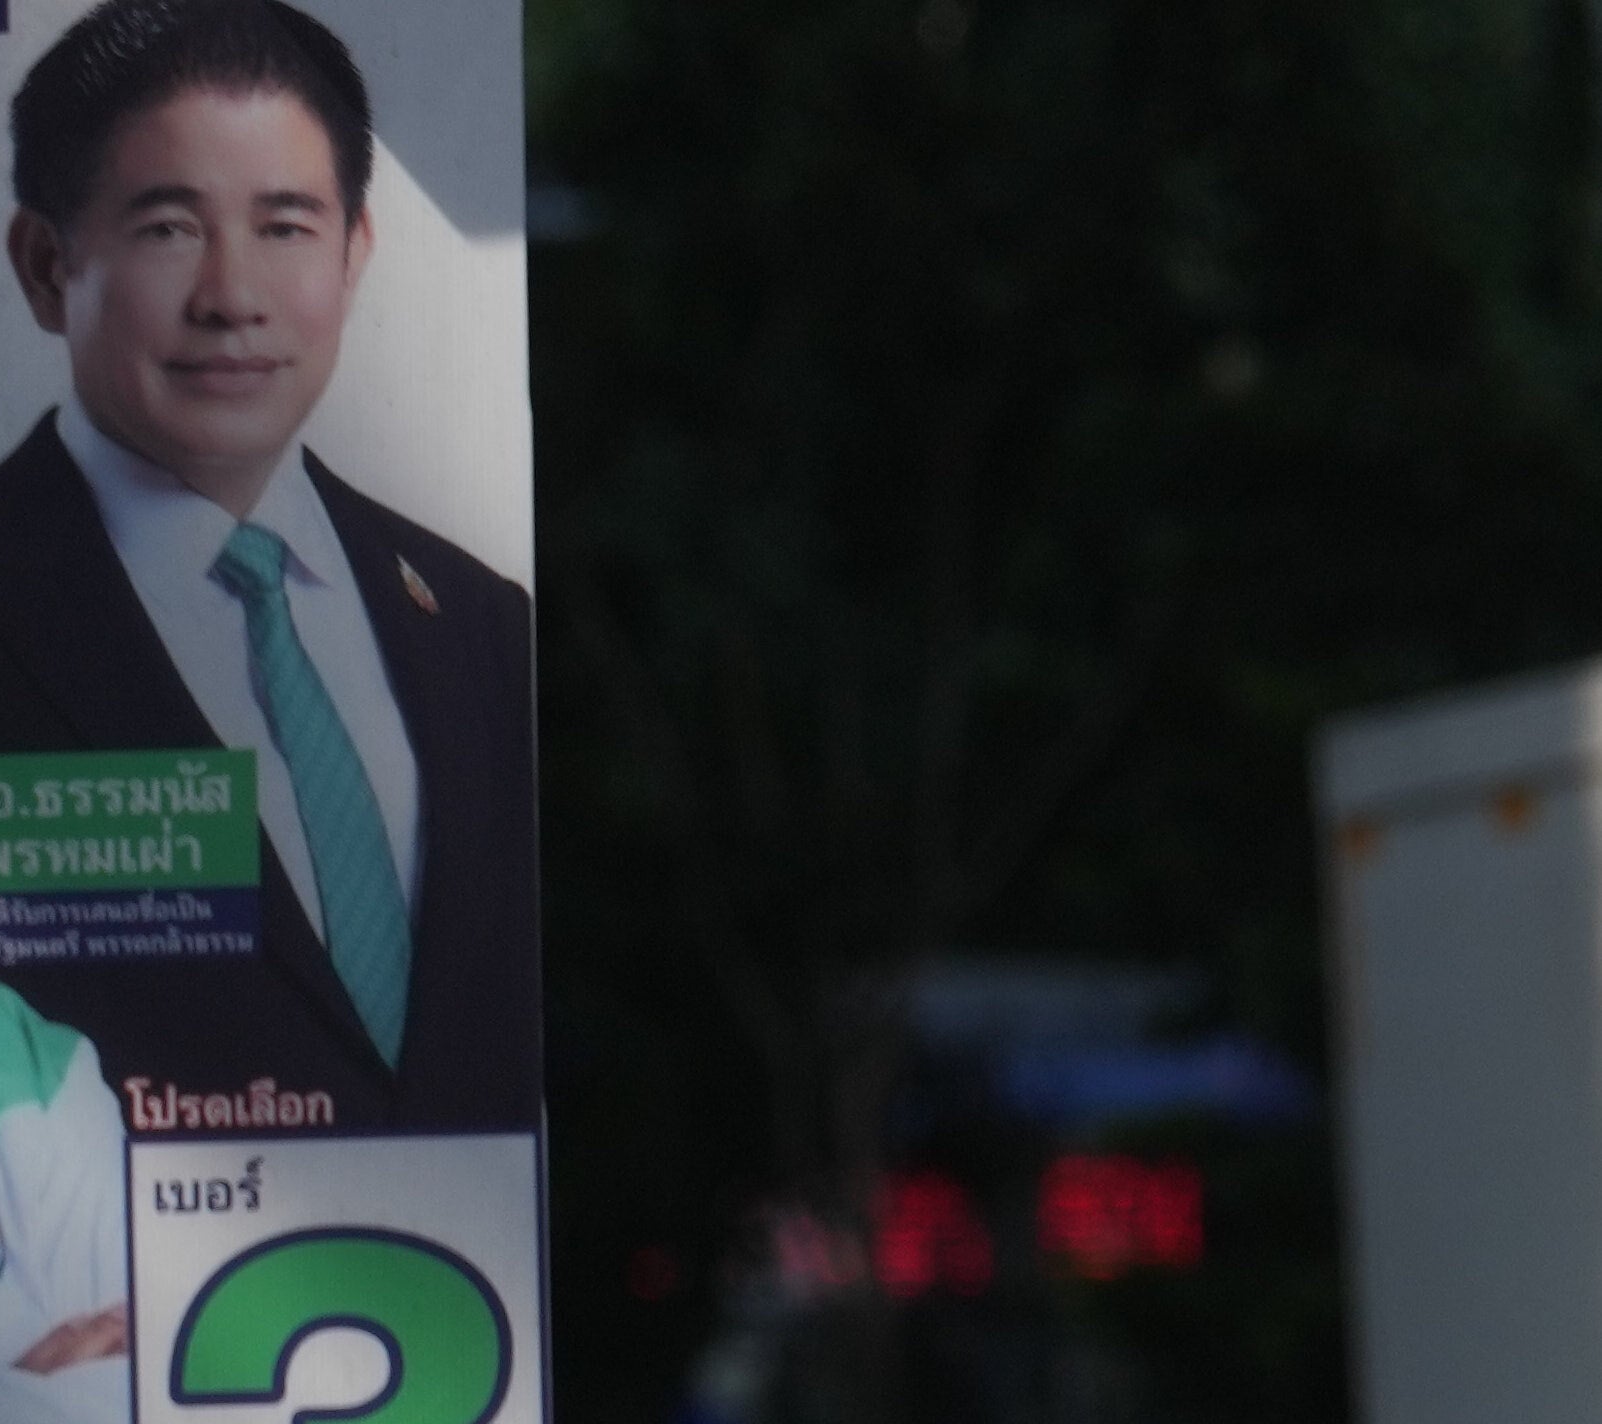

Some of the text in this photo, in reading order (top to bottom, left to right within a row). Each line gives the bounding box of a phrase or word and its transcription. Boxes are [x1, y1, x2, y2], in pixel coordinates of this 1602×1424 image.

[124, 1078, 333, 1129] โปรดเลือก
[155, 1157, 263, 1214] เบอร์
